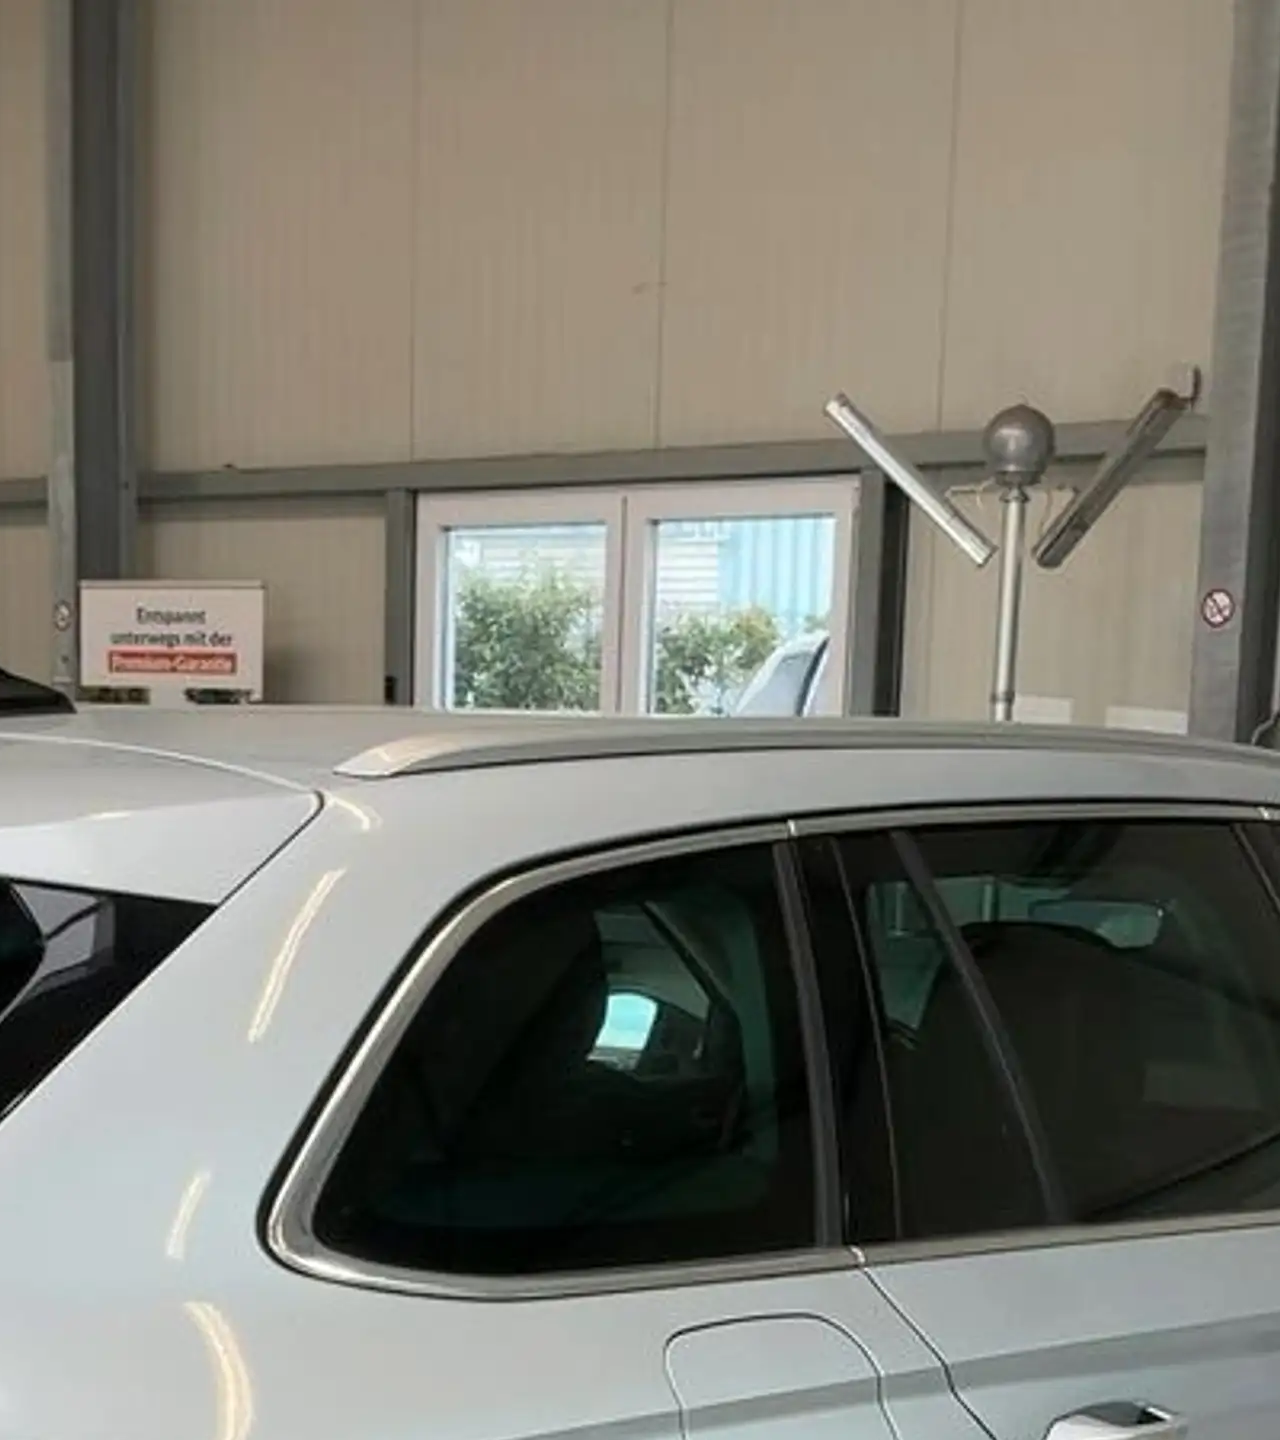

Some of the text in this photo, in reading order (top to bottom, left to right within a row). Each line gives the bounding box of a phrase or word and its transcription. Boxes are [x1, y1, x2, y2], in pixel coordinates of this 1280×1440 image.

[136, 608, 206, 625] Entspannt
[109, 631, 233, 648] unterwegs mit der
